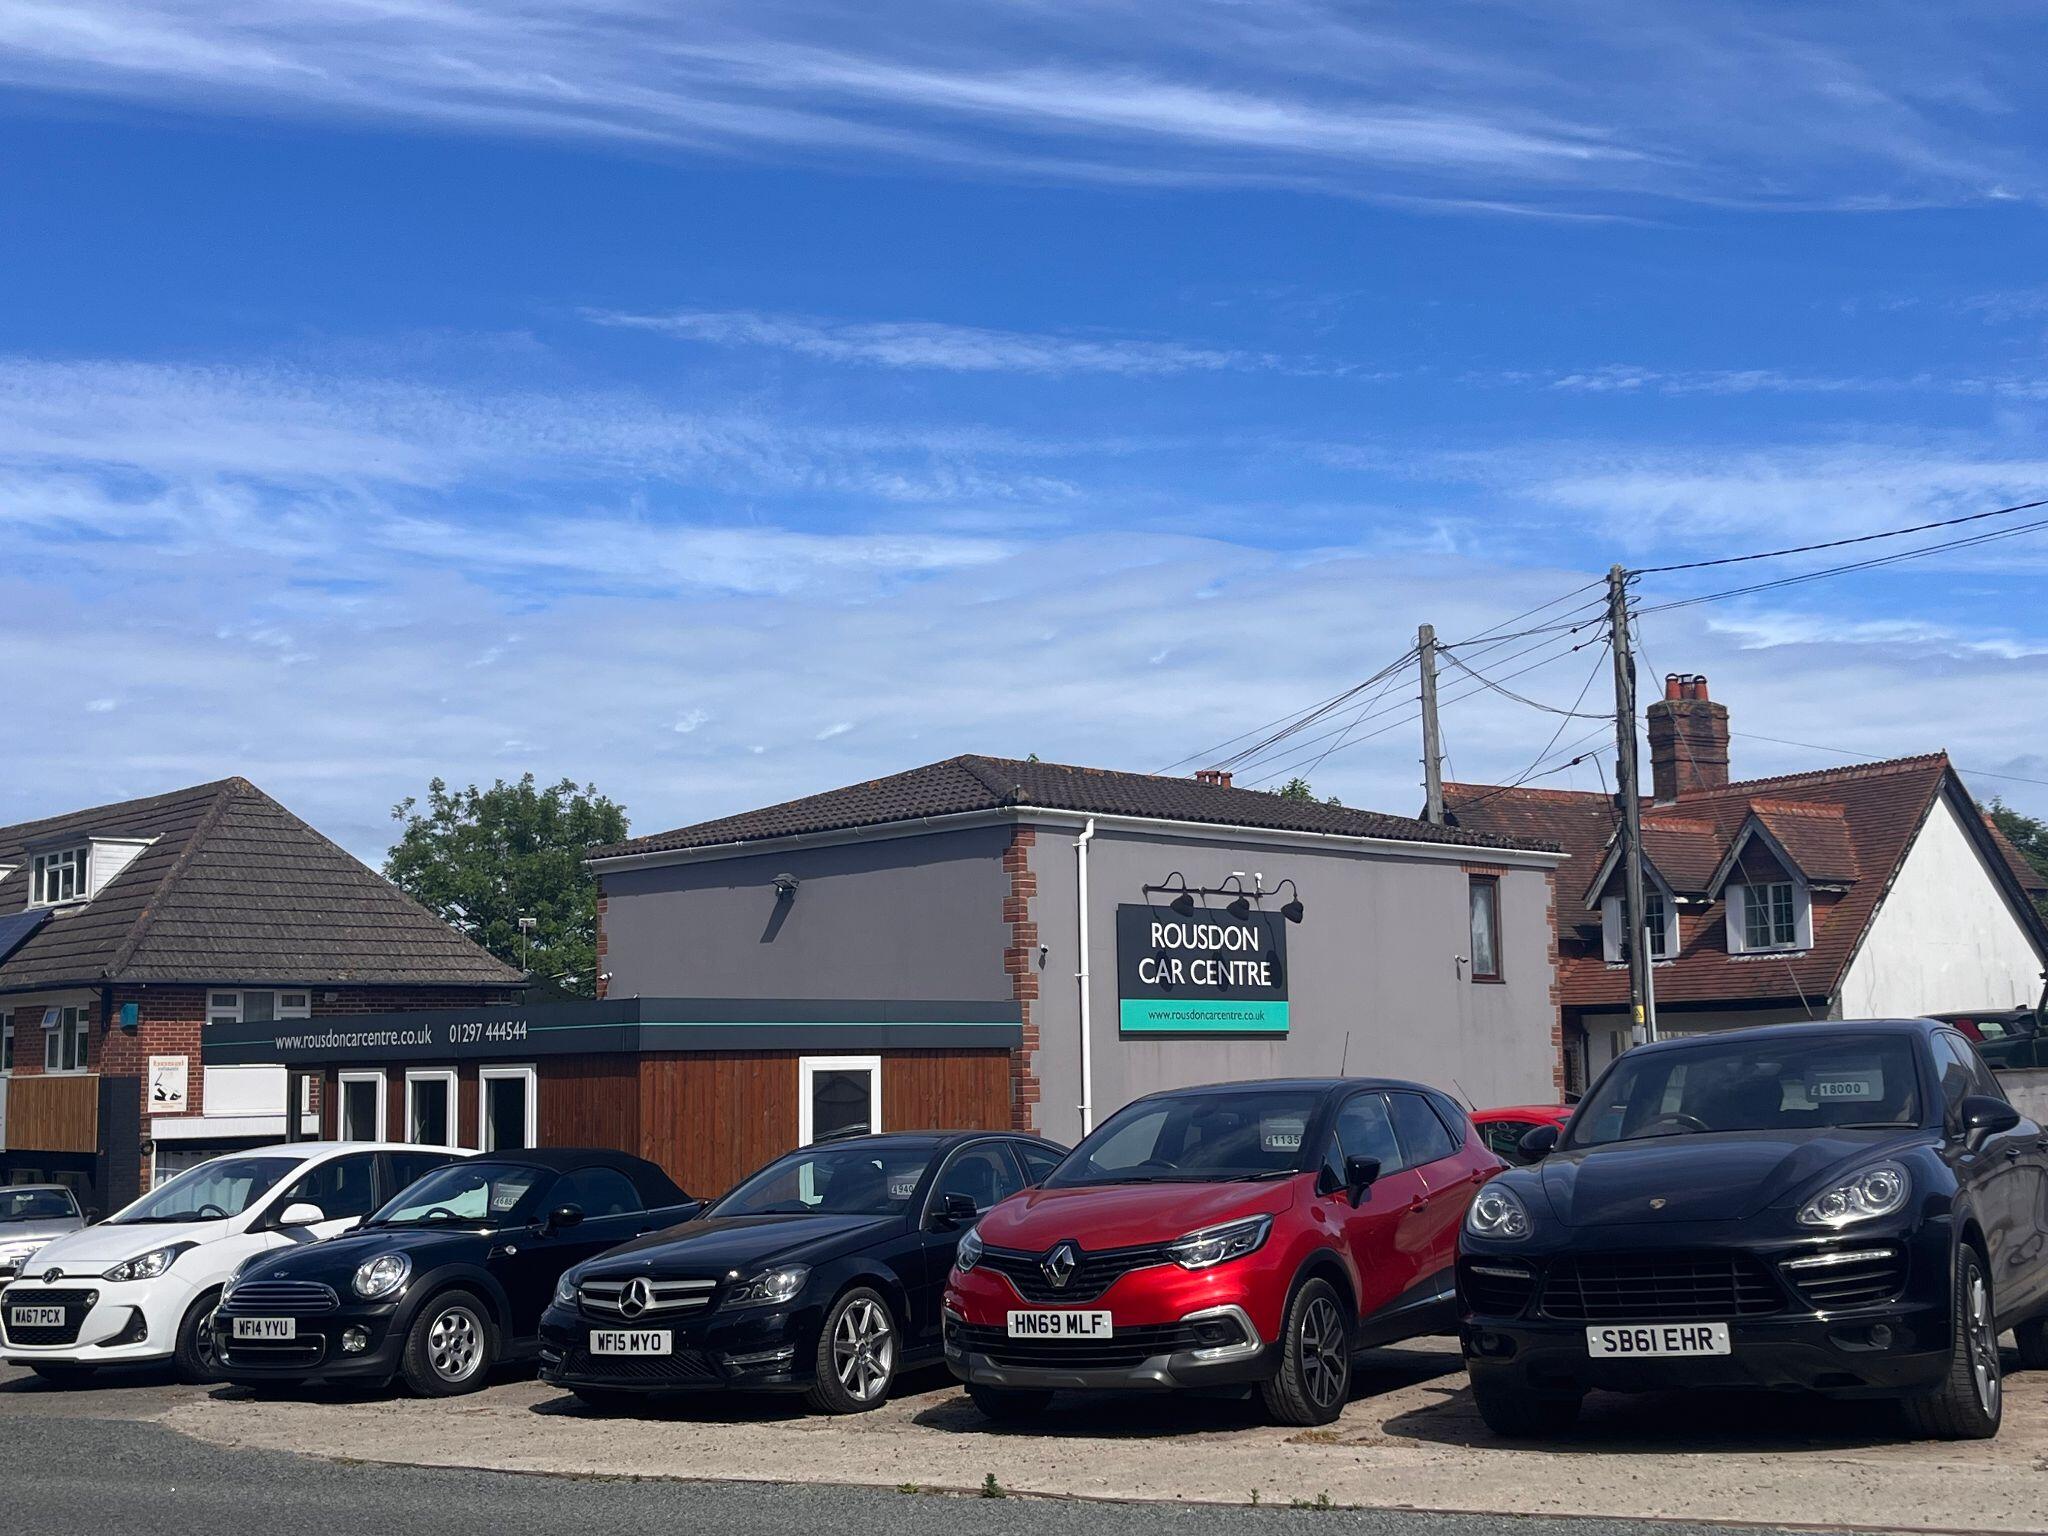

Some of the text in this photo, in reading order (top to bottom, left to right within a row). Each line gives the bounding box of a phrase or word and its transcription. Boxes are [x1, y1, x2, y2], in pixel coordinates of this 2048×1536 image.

[1151, 922, 1259, 951] ROUSDON
[1138, 957, 1272, 986] CAR CENTRE
[1148, 1008, 1265, 1021] www.rousdoncarcentre.co.uk
[275, 1020, 528, 1050] www.rousdoncarcentre.co.uk 01297 444544
[15, 1308, 61, 1324] WA67 PCX
[1015, 1314, 1103, 1334] HN69 MLF
[239, 1320, 288, 1336] WF14 YYU
[598, 1333, 661, 1351] WF15 MYO
[1602, 1326, 1714, 1353] SB61 EHR
